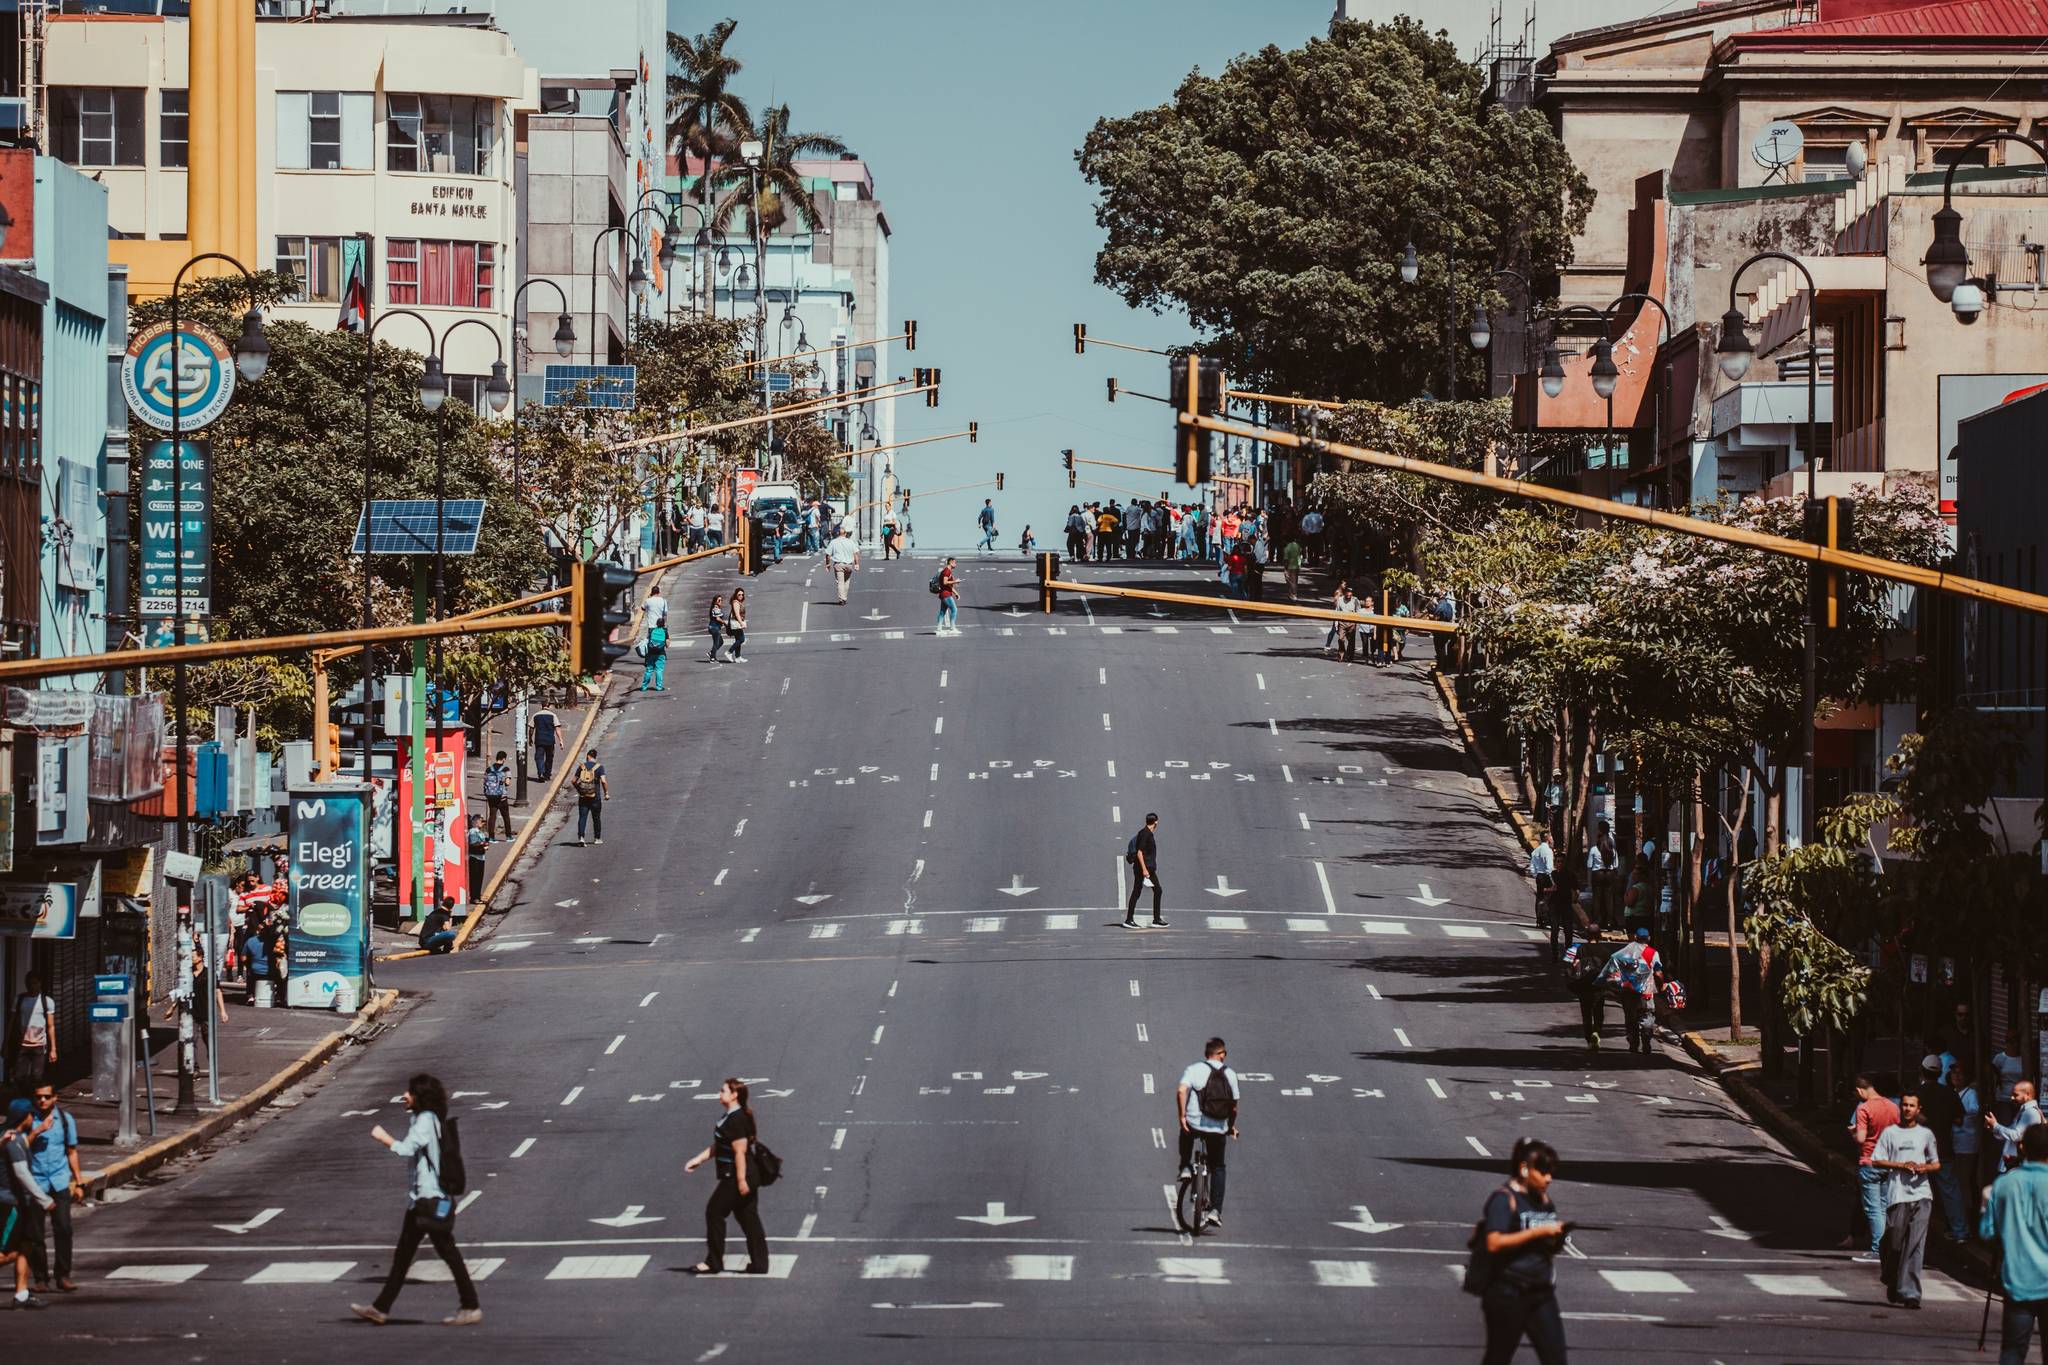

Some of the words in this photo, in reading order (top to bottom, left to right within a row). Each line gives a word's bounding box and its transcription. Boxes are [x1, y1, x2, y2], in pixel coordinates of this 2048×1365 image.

[1771, 128, 1789, 136] SKY
[432, 185, 474, 200] EDIFICIO
[411, 202, 446, 217] SANTA
[132, 320, 185, 354] HOBBIES
[192, 323, 224, 353] SHOP
[124, 366, 141, 407] VARIEDAD
[138, 405, 150, 418] EN
[148, 413, 203, 429] VIDEOEGOS
[148, 459, 174, 470] XBO
[182, 459, 205, 470] ONE
[188, 520, 200, 531] U
[150, 587, 200, 596] Teleono
[146, 600, 206, 611] 2256-714
[298, 840, 353, 869] Elegí
[298, 873, 357, 890] creer.
[295, 950, 327, 958] movistar
